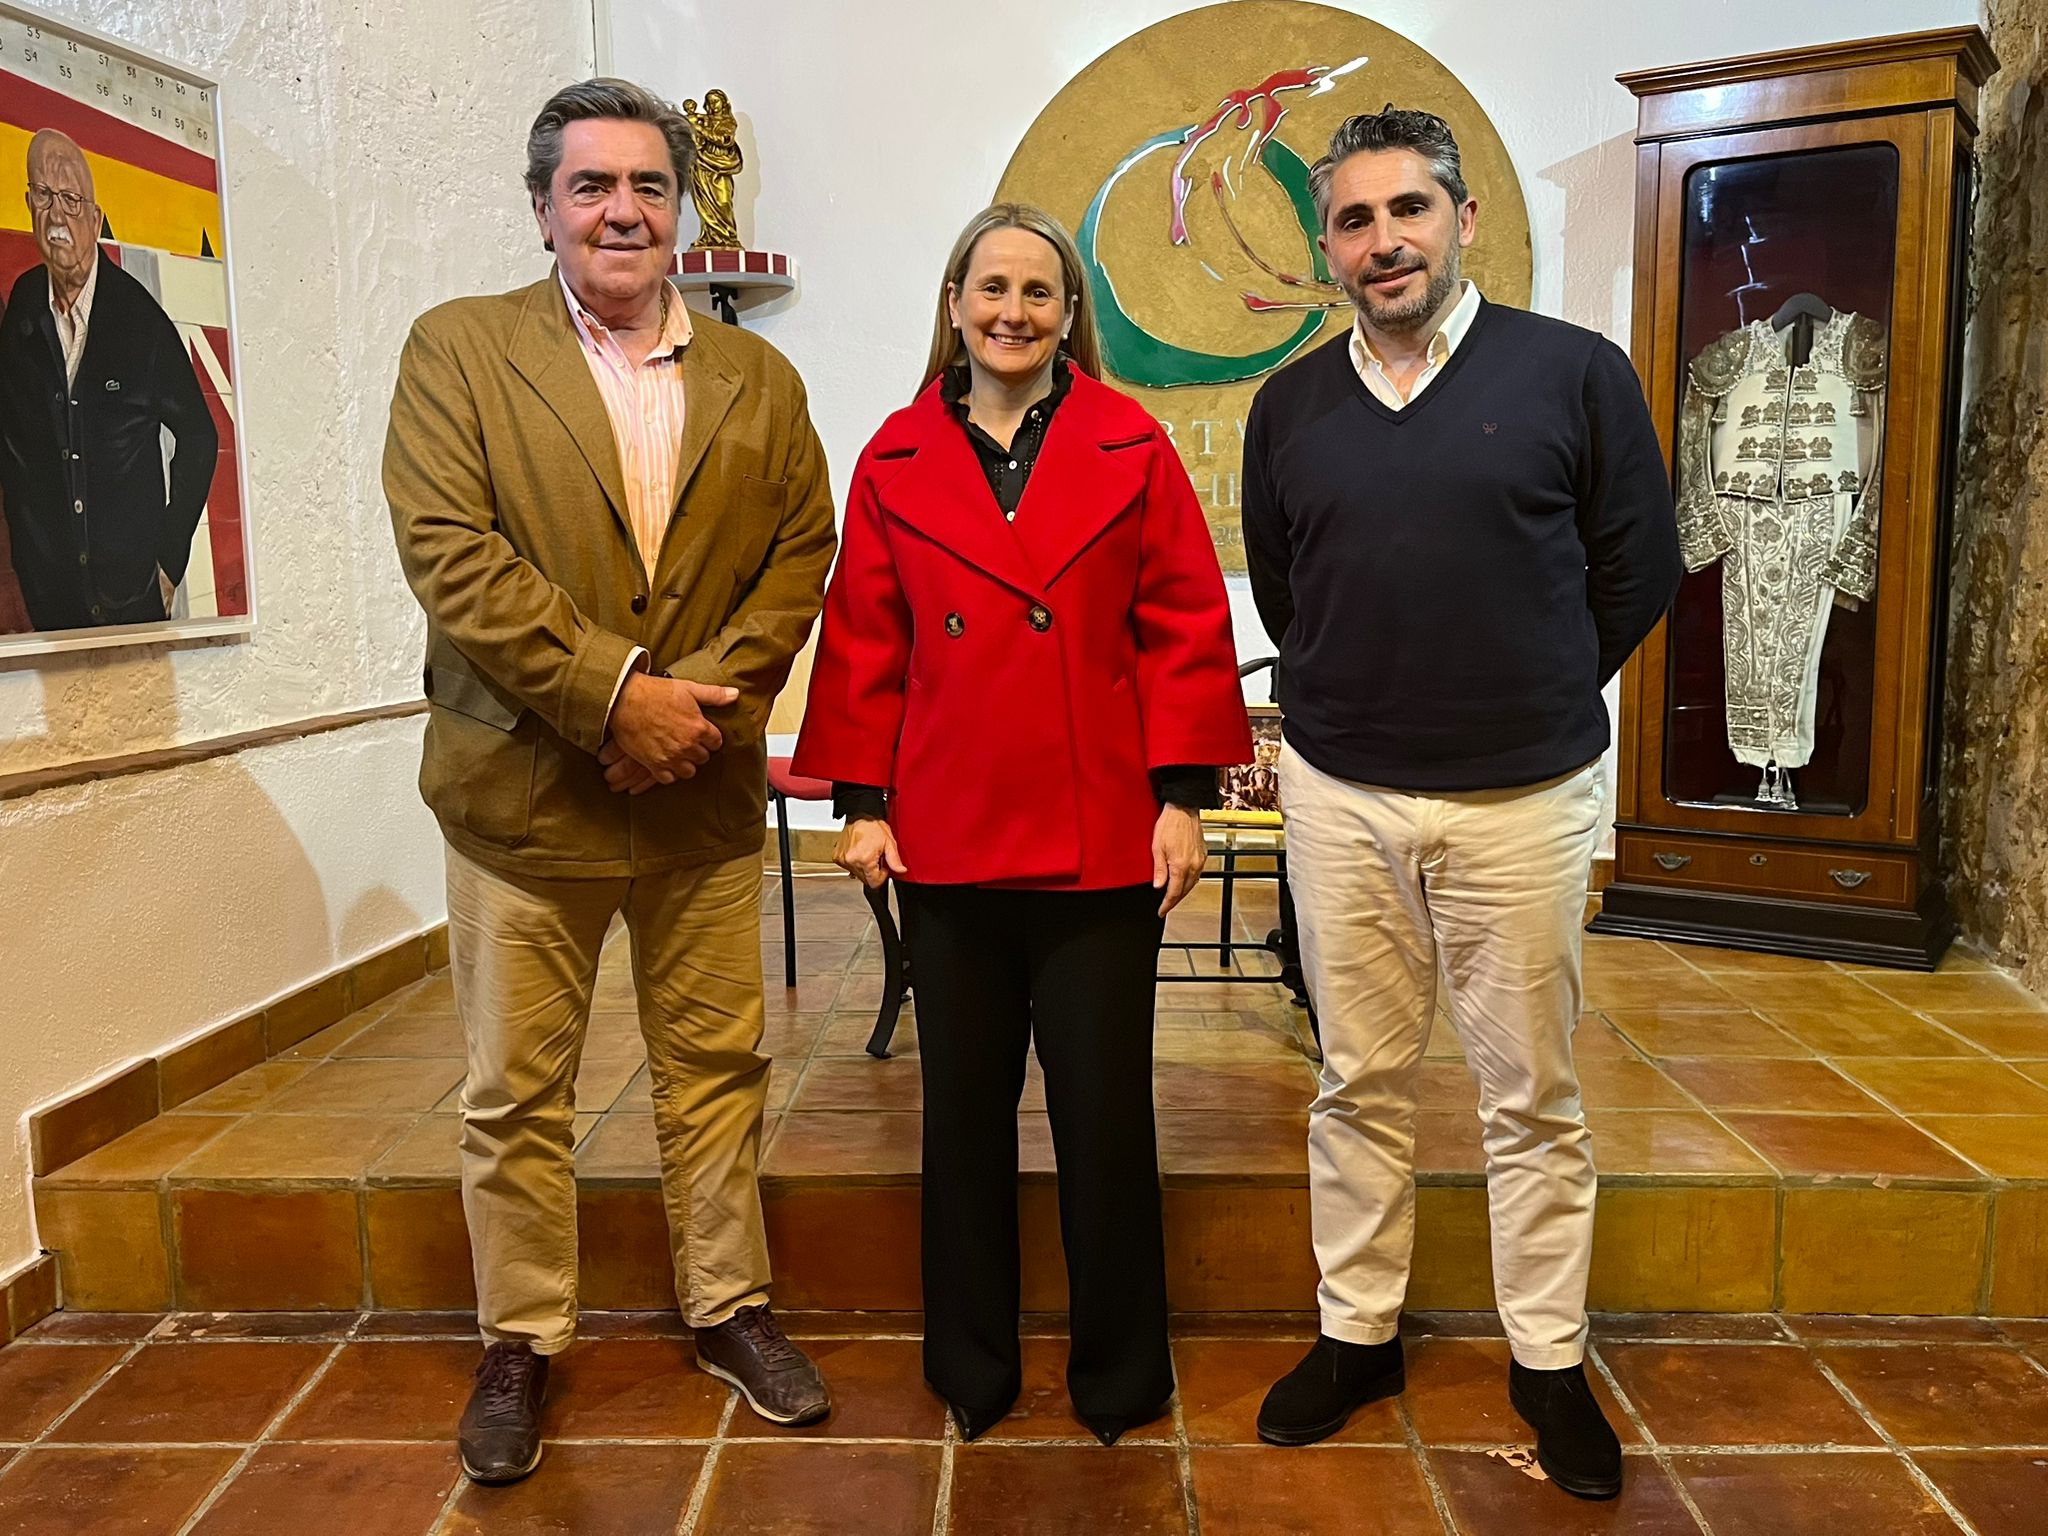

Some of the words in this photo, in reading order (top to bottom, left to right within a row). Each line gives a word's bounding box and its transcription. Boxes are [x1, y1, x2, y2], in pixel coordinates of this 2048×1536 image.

[24, 49, 37, 62] 54
[60, 65, 72, 79] 55
[175, 118, 184, 130] 59
[197, 128, 207, 140] 60
[27, 26, 40, 39] 55
[67, 41, 77, 53] 56
[98, 54, 109, 67] 57
[176, 83, 185, 95] 60
[200, 91, 208, 102] 61
